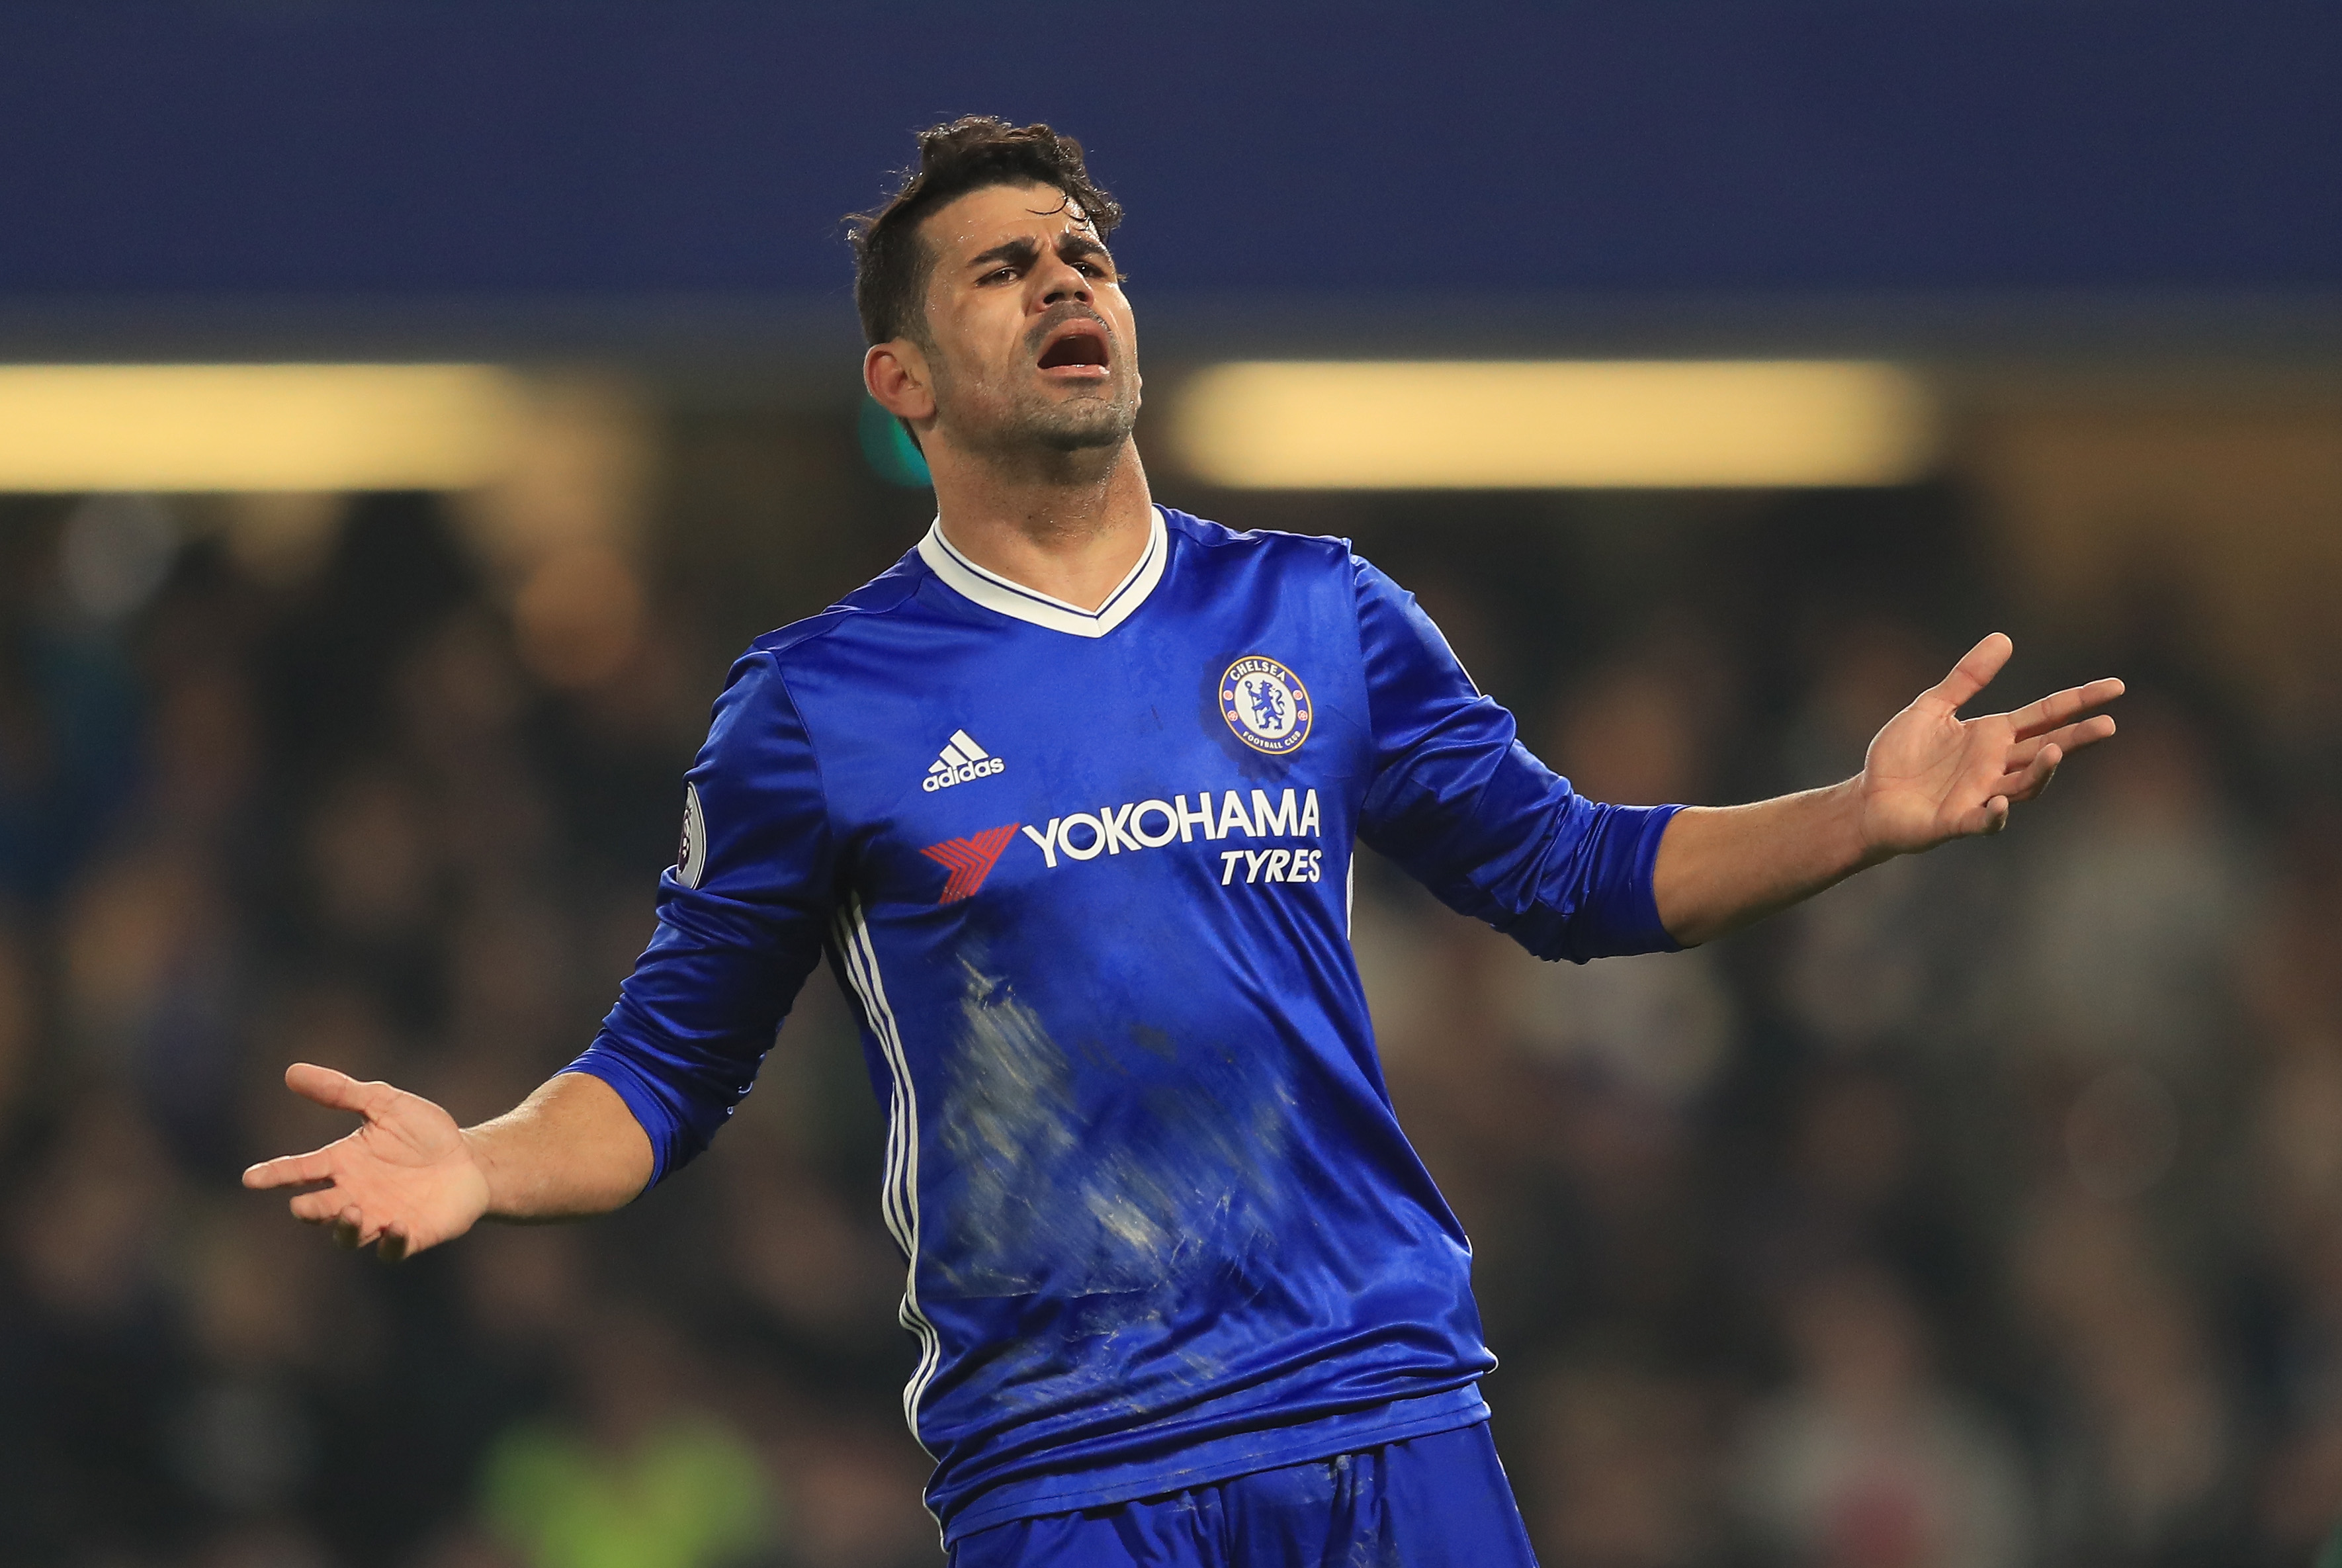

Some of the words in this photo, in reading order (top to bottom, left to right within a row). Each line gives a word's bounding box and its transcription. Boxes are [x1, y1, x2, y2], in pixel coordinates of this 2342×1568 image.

[1230, 660, 1287, 681] CHELSEA
[1242, 731, 1283, 749] FOOTBALL
[1284, 730, 1301, 746] CLUB
[922, 756, 1004, 792] adidas
[1022, 789, 1321, 868] YOKOHAMA
[1221, 849, 1321, 885] TYRES
